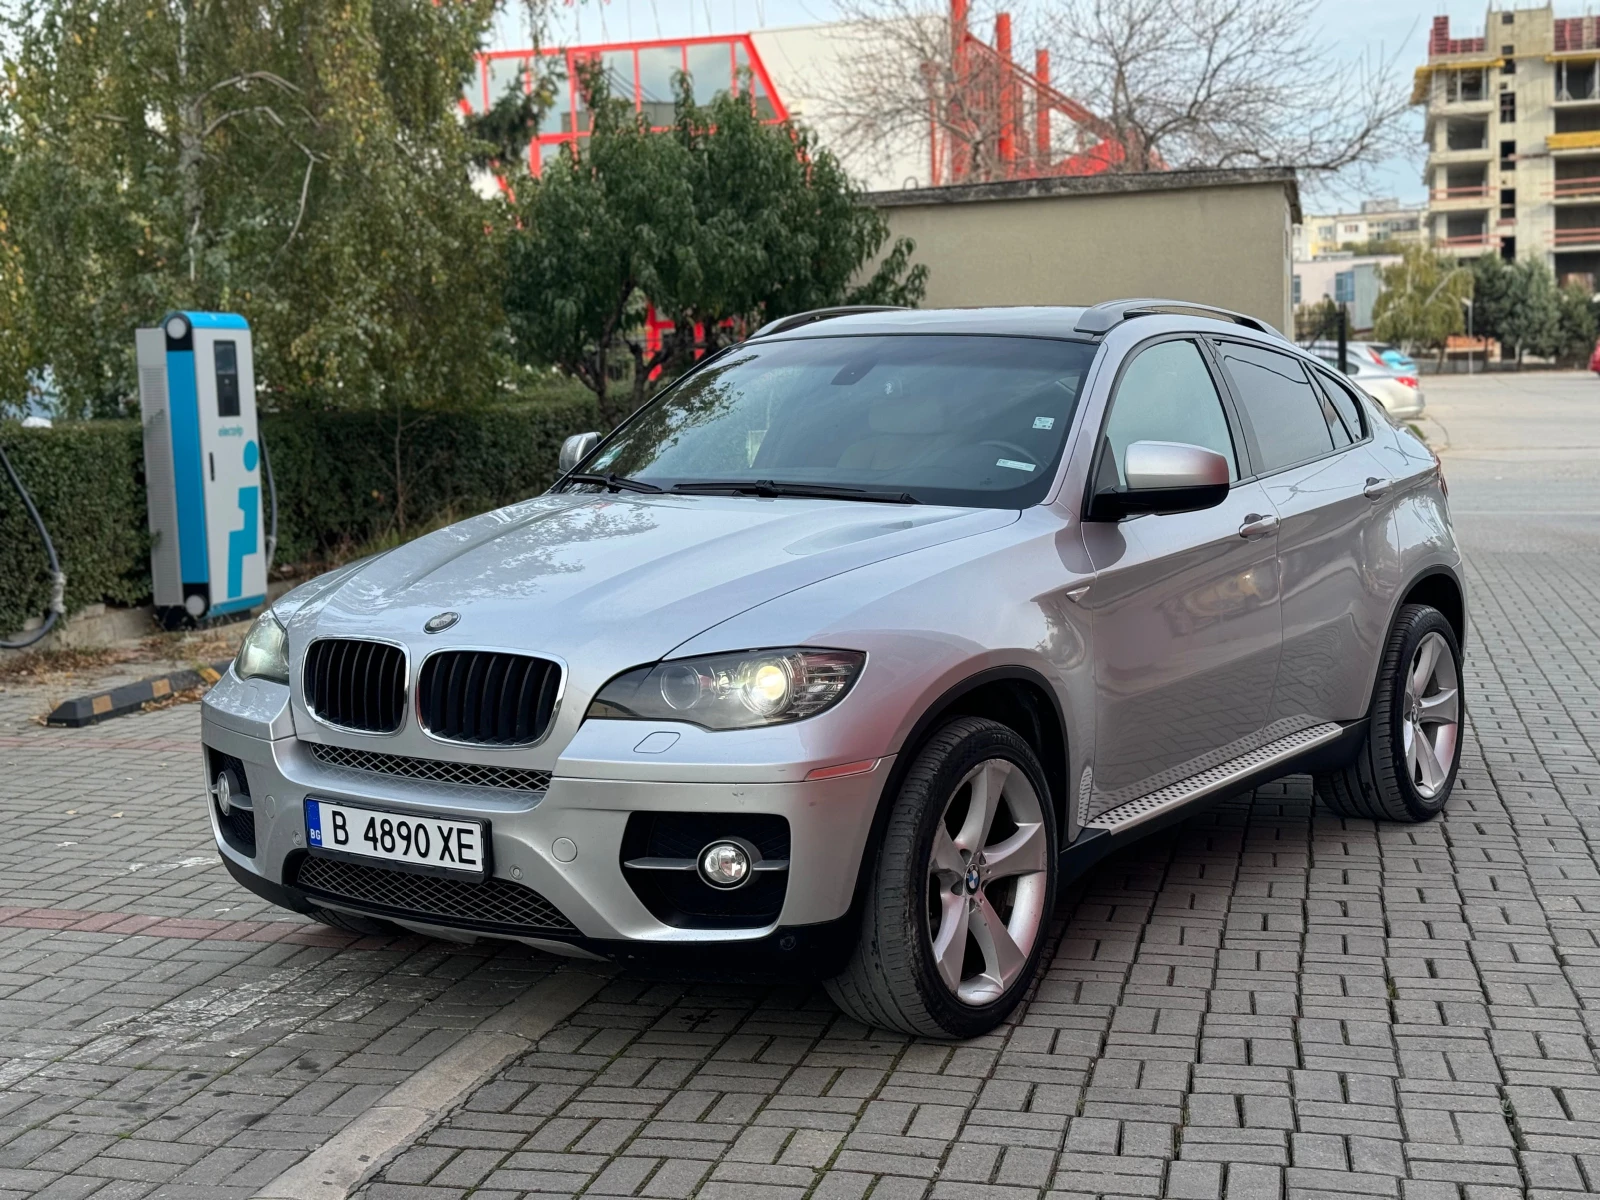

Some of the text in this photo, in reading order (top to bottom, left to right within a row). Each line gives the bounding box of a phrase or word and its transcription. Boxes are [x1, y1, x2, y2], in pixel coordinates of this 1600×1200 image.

[310, 828, 321, 841] BG
[331, 810, 477, 865] B 4890 XE
